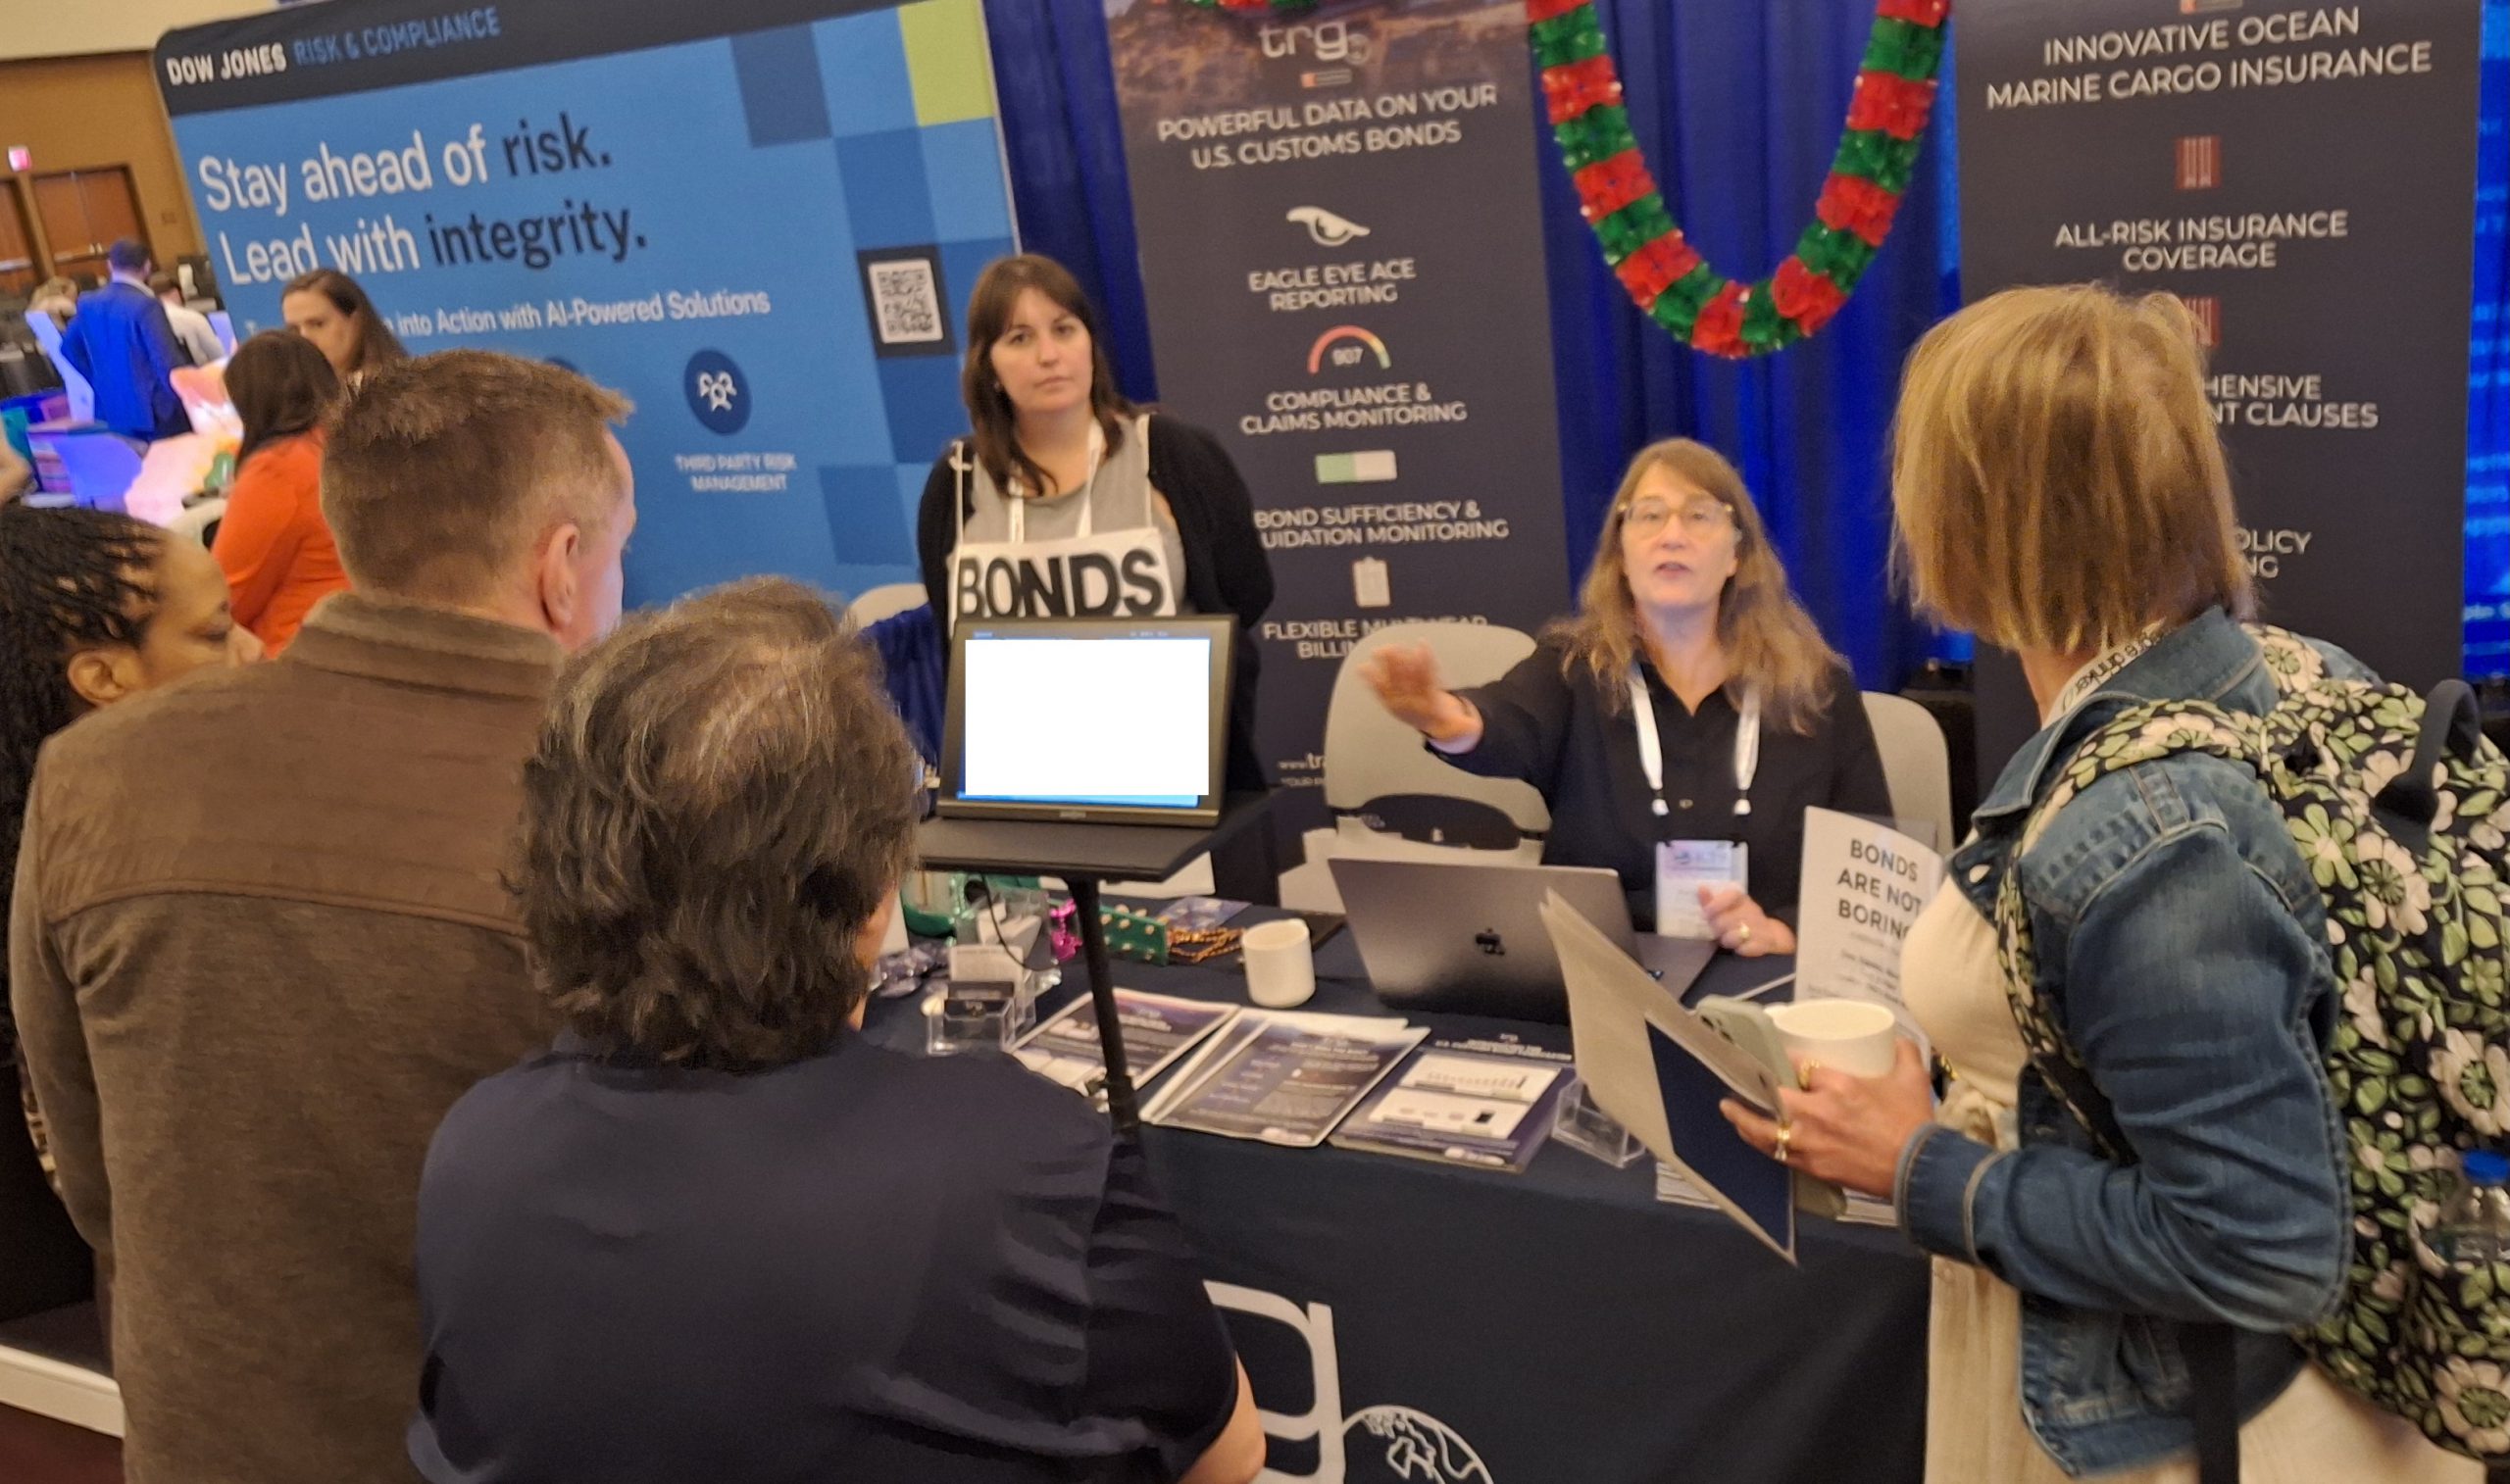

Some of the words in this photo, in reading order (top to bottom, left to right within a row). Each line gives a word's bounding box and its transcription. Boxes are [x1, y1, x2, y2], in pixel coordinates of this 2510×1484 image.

[167, 56, 214, 85] DOW
[221, 42, 287, 80] JONES
[294, 35, 340, 66] RISK
[345, 33, 360, 59] &
[363, 8, 501, 57] COMPLIANCE
[1258, 21, 1348, 61] trg
[2043, 20, 2230, 67] INNOVATIVE
[2237, 6, 2359, 47] OCEAN
[1986, 73, 2101, 111] MARINE
[2109, 62, 2222, 99] CARGO
[2231, 40, 2433, 88] INSURANCE
[1158, 107, 1301, 144] POWERFUL
[1304, 99, 1372, 126] DATA
[1376, 92, 1416, 119] ON
[1422, 82, 1498, 111] YOUR
[199, 155, 287, 217] Stay
[302, 129, 431, 202] ahead
[444, 124, 489, 184] of
[503, 112, 612, 176] risk.
[1190, 144, 1235, 171] U.S.
[1238, 130, 1362, 166] CUSTOMS
[1367, 120, 1462, 152] BONDS
[220, 223, 320, 285] Lead
[327, 214, 421, 274] with
[426, 200, 647, 271] integrity.
[2054, 218, 2171, 249] ALL-RISK
[2178, 209, 2348, 243] INSURANCE
[1248, 267, 1321, 292] EAGLE
[1325, 263, 1366, 285] EYE
[1371, 258, 1417, 281] ACE
[2123, 241, 2277, 272] COVERAGE
[396, 311, 432, 337] into
[437, 307, 496, 335] Action
[499, 301, 541, 329] with
[547, 292, 665, 327] AI-Powered
[668, 289, 772, 320] Solutions
[1271, 283, 1398, 312] REPORTING
[1267, 383, 1412, 413] COMPLIANCE
[1416, 381, 1431, 402] &
[2205, 373, 2322, 401] HENSIVE
[1240, 411, 1321, 436] CLAIMS
[1324, 401, 1469, 429] MONITORING
[2245, 401, 2380, 429] CLAUSES
[1253, 508, 1319, 530] BOND
[1323, 500, 1462, 526] SUFFICIENCY
[1464, 499, 1481, 519] &
[1260, 527, 1362, 549] UIDATION
[1367, 519, 1510, 544] MONITORING
[2235, 526, 2313, 555] OLICY
[957, 548, 1167, 617] BONDS
[1263, 618, 1358, 640] FLEXIBLE
[1850, 838, 1918, 882] BONDS
[1836, 867, 1882, 899] ARE
[1886, 883, 1923, 918] NOT
